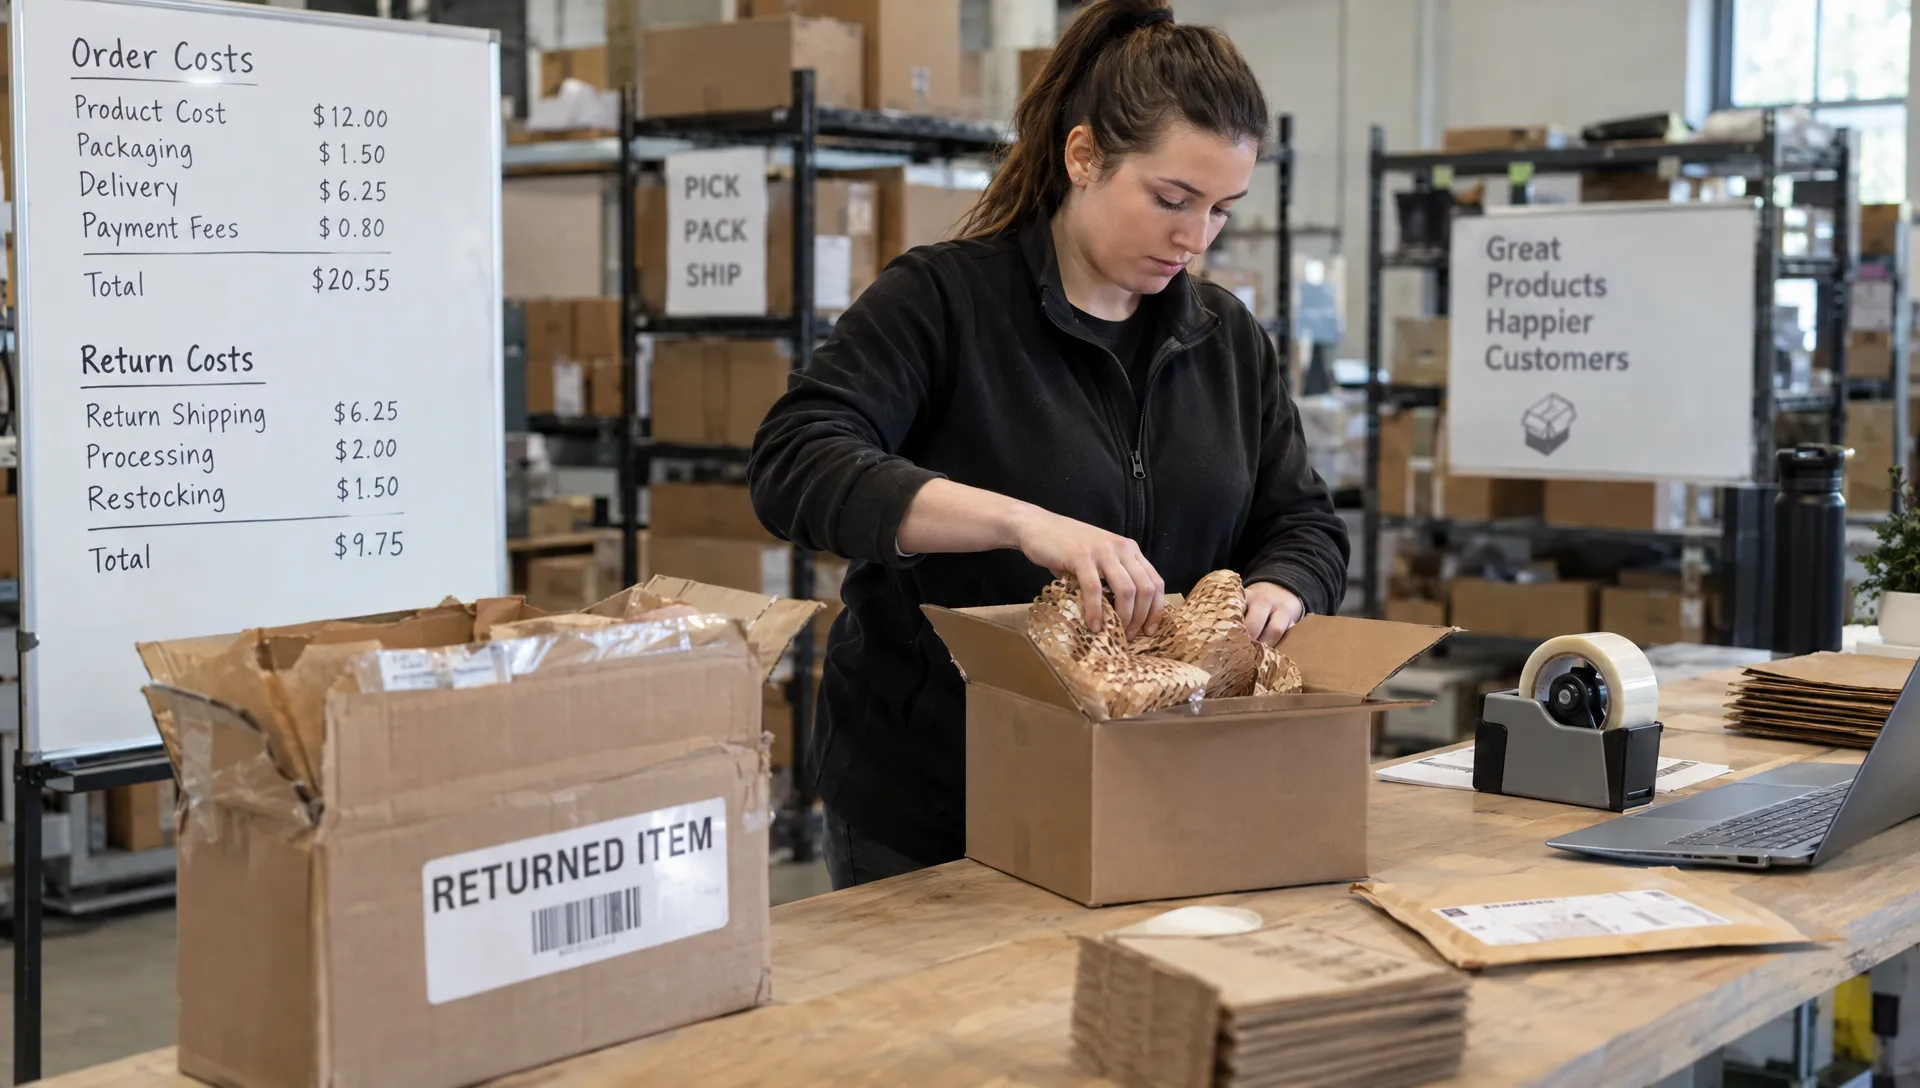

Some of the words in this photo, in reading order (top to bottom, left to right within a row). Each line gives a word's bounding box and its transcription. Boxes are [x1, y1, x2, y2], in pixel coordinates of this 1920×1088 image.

[71, 36, 158, 70] Order
[174, 40, 254, 74] Costs
[74, 94, 163, 123] Product
[175, 99, 227, 125] Cost
[313, 102, 388, 129] $12.00
[77, 131, 193, 170] Packaging
[79, 170, 178, 207] Delivery
[684, 174, 740, 200] PICK
[82, 211, 179, 247] Payment
[190, 215, 239, 240] Fees
[684, 218, 747, 243] PACK
[1485, 234, 1561, 262] Great
[83, 270, 144, 298] Total
[312, 265, 390, 294] $20.55
[686, 262, 742, 288] SHIP
[1486, 270, 1608, 299] Products
[1486, 307, 1594, 341] Happier
[80, 344, 174, 375] Return
[186, 343, 254, 373] Costs
[1484, 343, 1630, 372] Customers
[86, 402, 161, 428] Return
[172, 401, 266, 434] Shipping
[334, 400, 398, 426] $6.25
[86, 442, 214, 474] Processing
[335, 438, 397, 464] $2.00
[88, 482, 226, 513] Restocking
[336, 475, 399, 503] $1.50
[88, 543, 150, 574] Total
[334, 530, 404, 561] $9.75
[432, 838, 624, 914] RETURNED
[638, 816, 714, 865] ITEM
